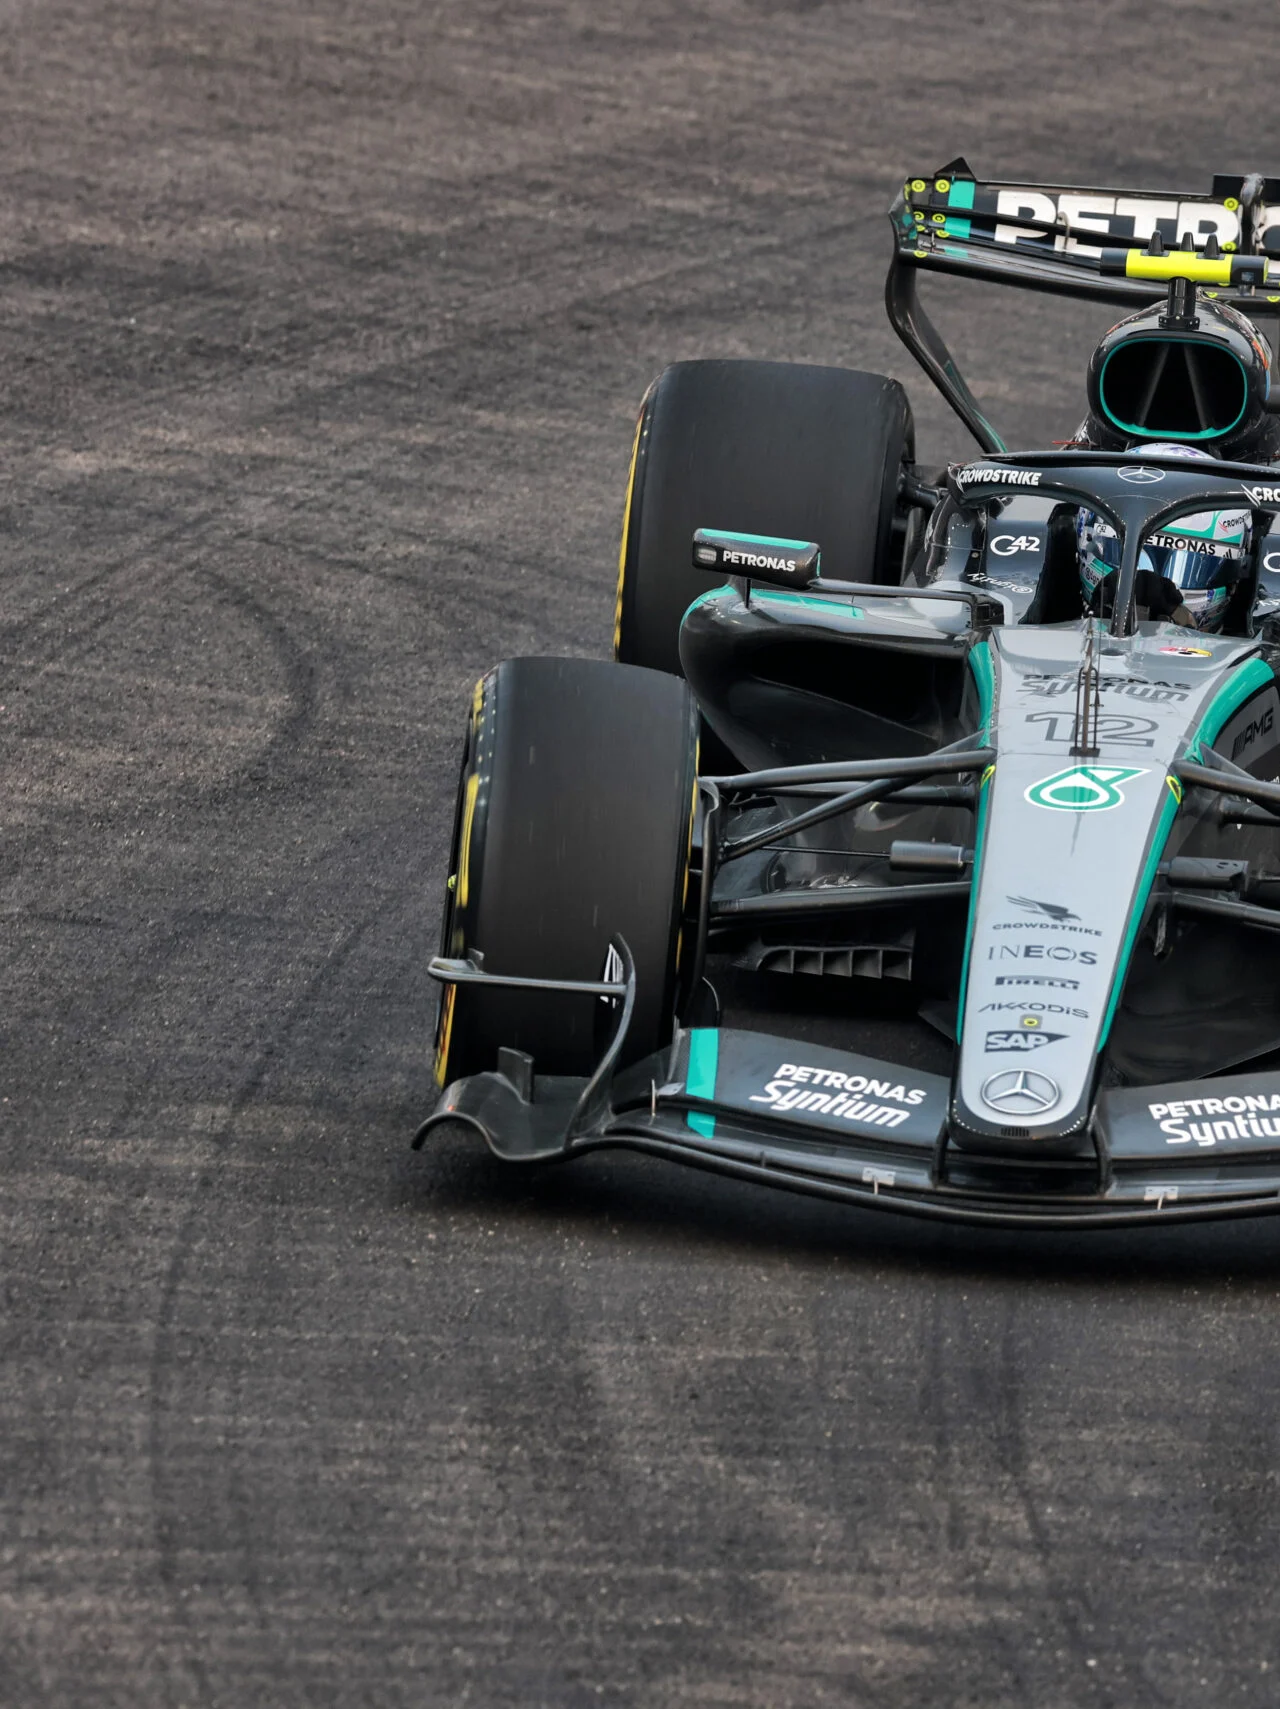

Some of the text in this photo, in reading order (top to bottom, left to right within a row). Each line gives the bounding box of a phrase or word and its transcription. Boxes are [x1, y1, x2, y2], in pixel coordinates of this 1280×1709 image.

[959, 469, 1042, 486] CROWDSTRIKE
[990, 535, 1040, 556] G42
[1145, 535, 1216, 556] ETRONAS
[722, 549, 796, 572] PETRONAS
[1025, 711, 1159, 748] 12
[1244, 707, 1273, 746] AMG
[992, 922, 1103, 937] CROWDSTRIKE
[988, 944, 1098, 966] INEOS
[995, 975, 1080, 990] PIRELLI
[986, 1032, 1049, 1050] SAP
[773, 1063, 927, 1105] PETRONAS
[748, 1079, 911, 1128] Syntium
